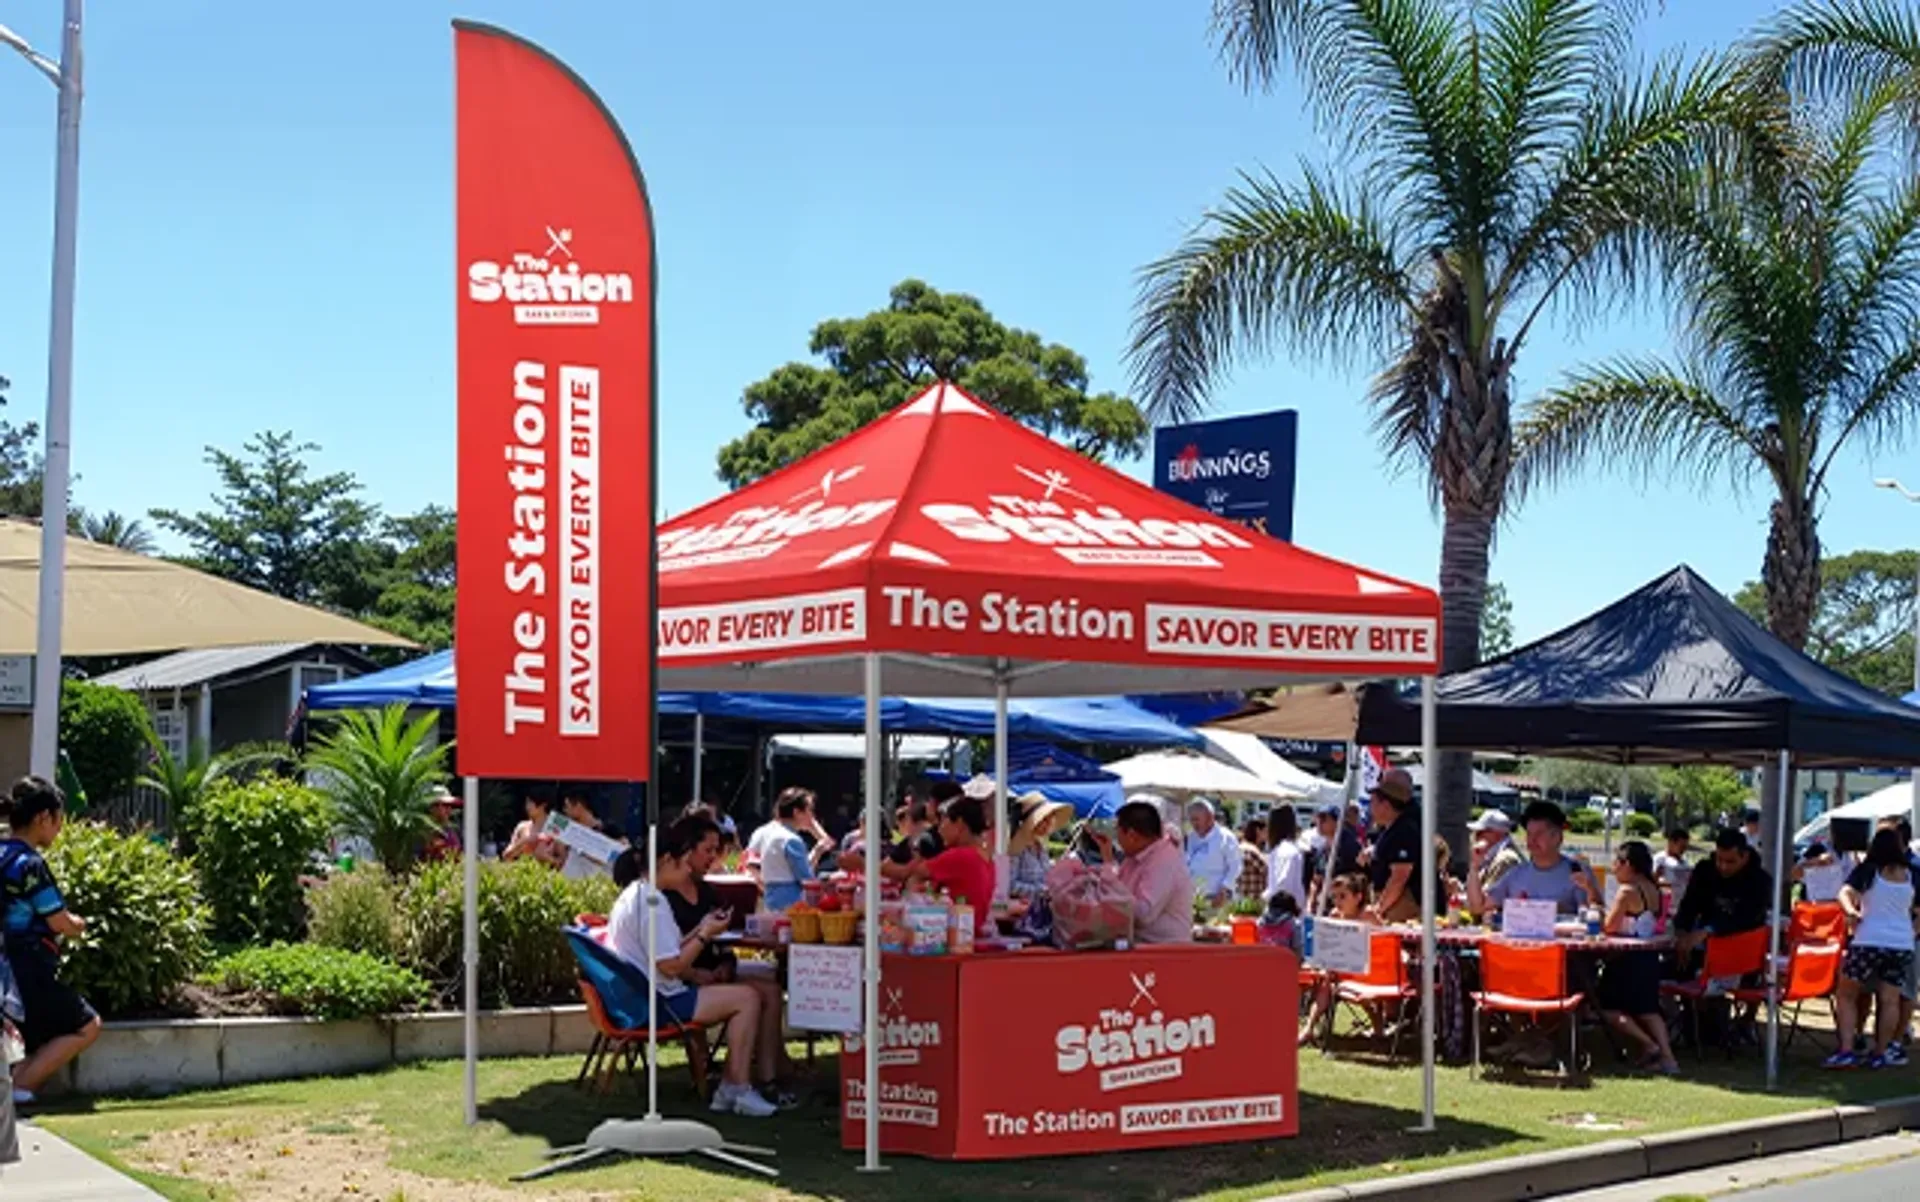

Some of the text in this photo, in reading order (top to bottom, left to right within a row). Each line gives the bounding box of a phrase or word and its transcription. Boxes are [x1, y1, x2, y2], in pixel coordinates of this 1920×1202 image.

[468, 261, 633, 302] Station
[513, 253, 548, 272] The
[919, 504, 1254, 548] Station
[989, 496, 1065, 516] The
[505, 361, 545, 735] The Station
[571, 380, 591, 723] SAVOR EVERY BITE
[657, 602, 854, 647] VOR EVERY BITE
[882, 586, 1428, 653] The Station SAVOR EVERY BITE
[1100, 1009, 1134, 1030] The
[1056, 1010, 1216, 1073] Station
[880, 1081, 938, 1104] tation
[984, 1112, 1027, 1136] The
[1033, 1108, 1115, 1134] Station
[1127, 1108, 1182, 1127] SAVOR
[1187, 1104, 1238, 1122] EVERY
